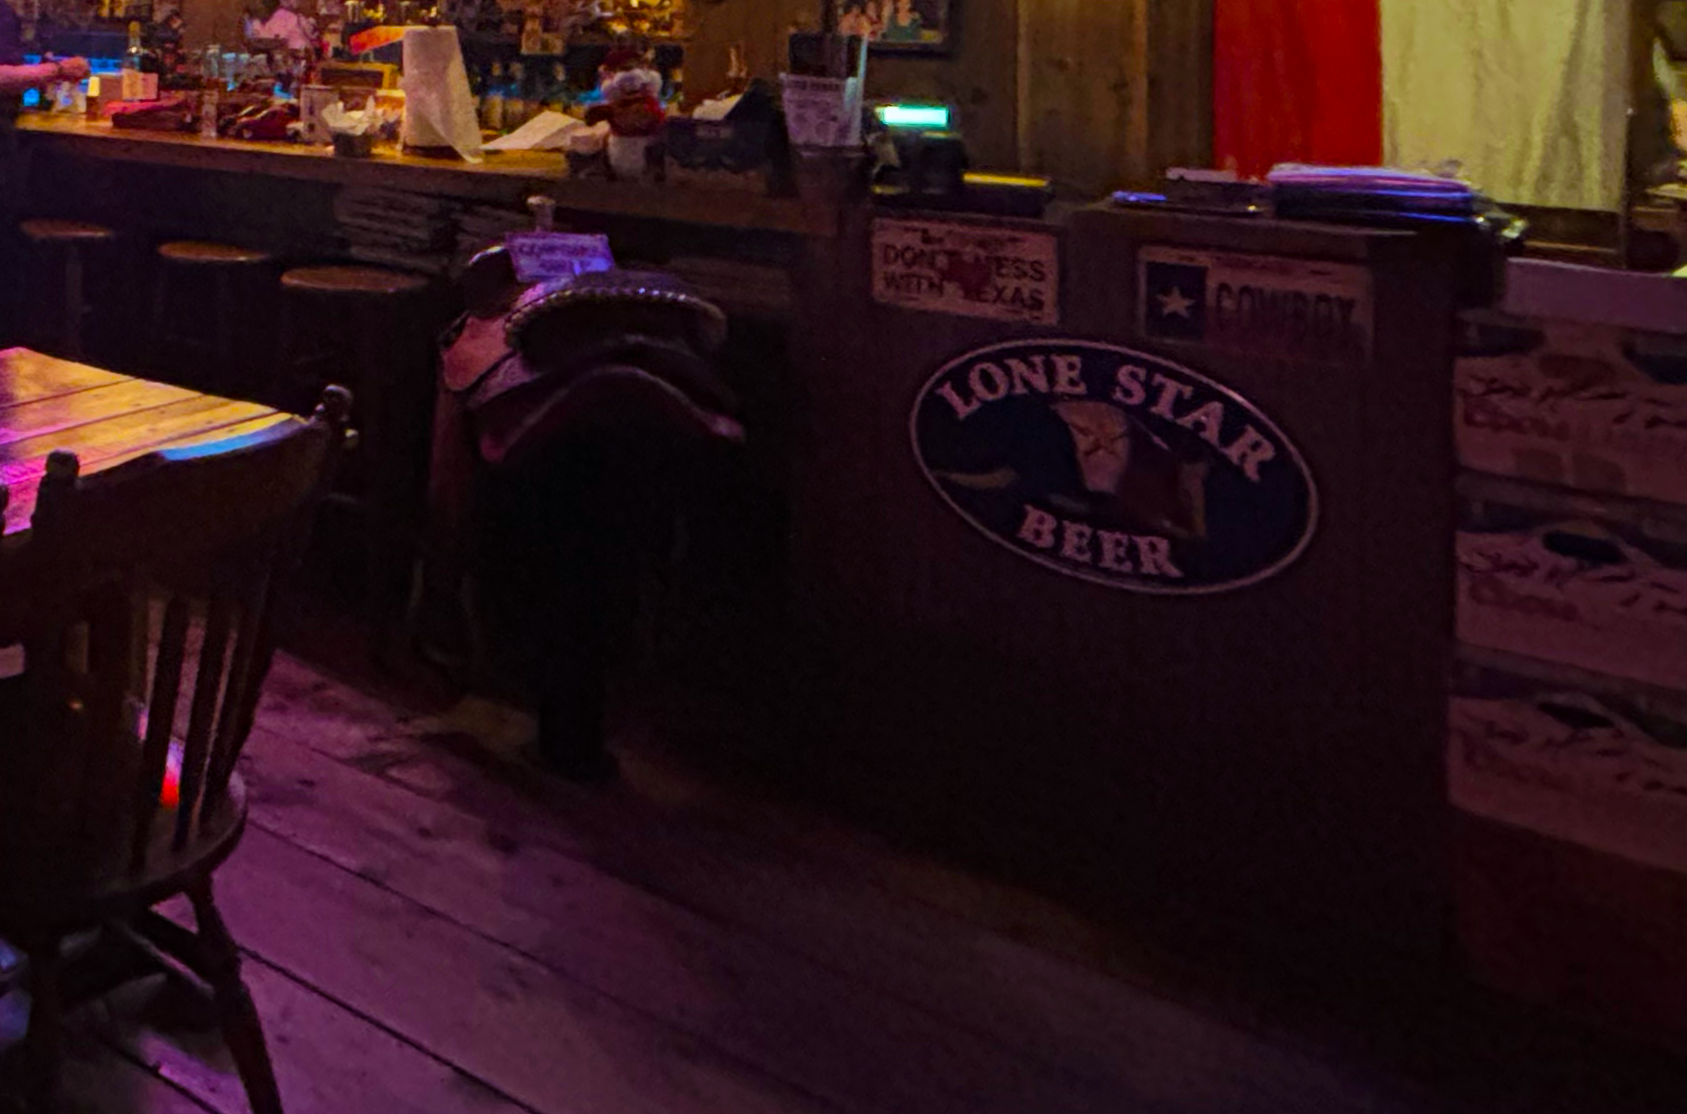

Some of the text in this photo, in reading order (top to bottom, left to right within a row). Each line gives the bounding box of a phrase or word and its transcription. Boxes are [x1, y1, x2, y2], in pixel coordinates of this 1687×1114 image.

[936, 354, 1278, 485] LONE STAR
[1016, 502, 1186, 579] BEER
